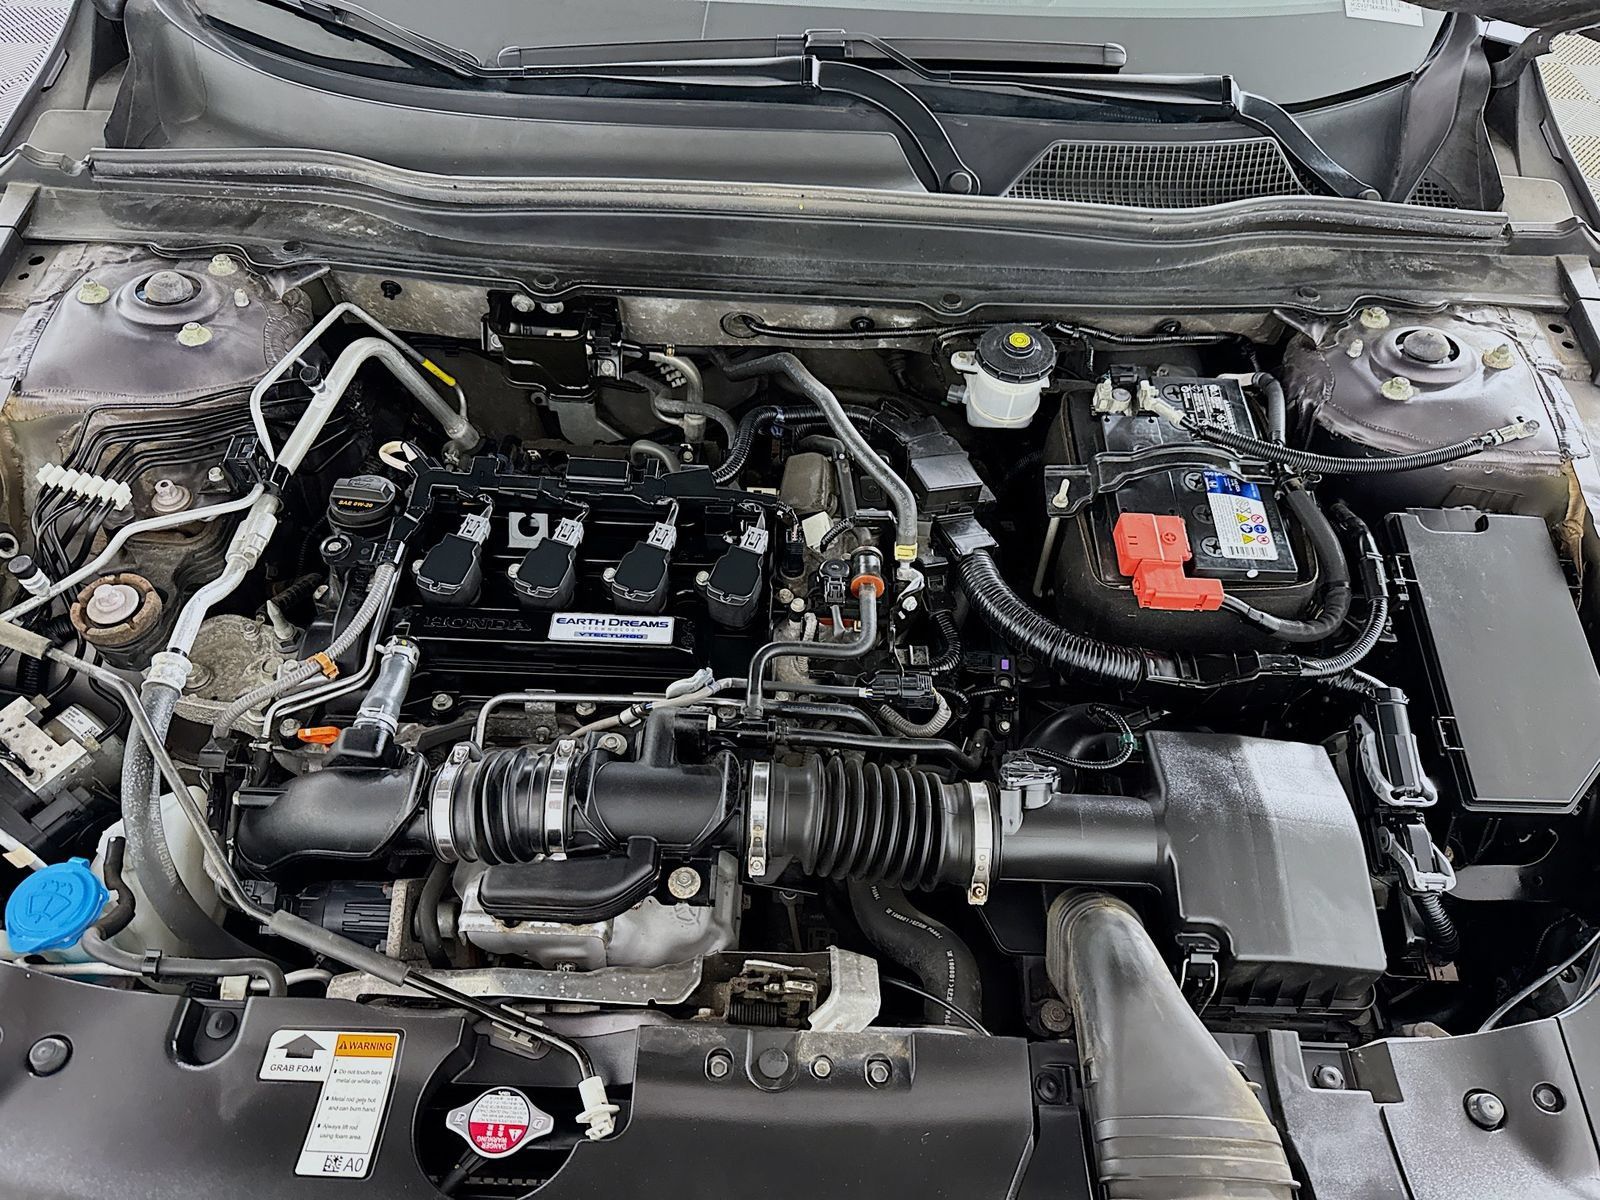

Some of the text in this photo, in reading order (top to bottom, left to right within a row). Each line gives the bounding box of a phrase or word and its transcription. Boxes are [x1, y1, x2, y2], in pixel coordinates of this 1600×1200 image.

[423, 616, 532, 632] HONDA
[556, 617, 669, 629] EARTH DREAMS
[349, 1041, 393, 1051] WARNING
[270, 1064, 322, 1073] GRAB FOAM
[343, 1157, 364, 1173] A0
